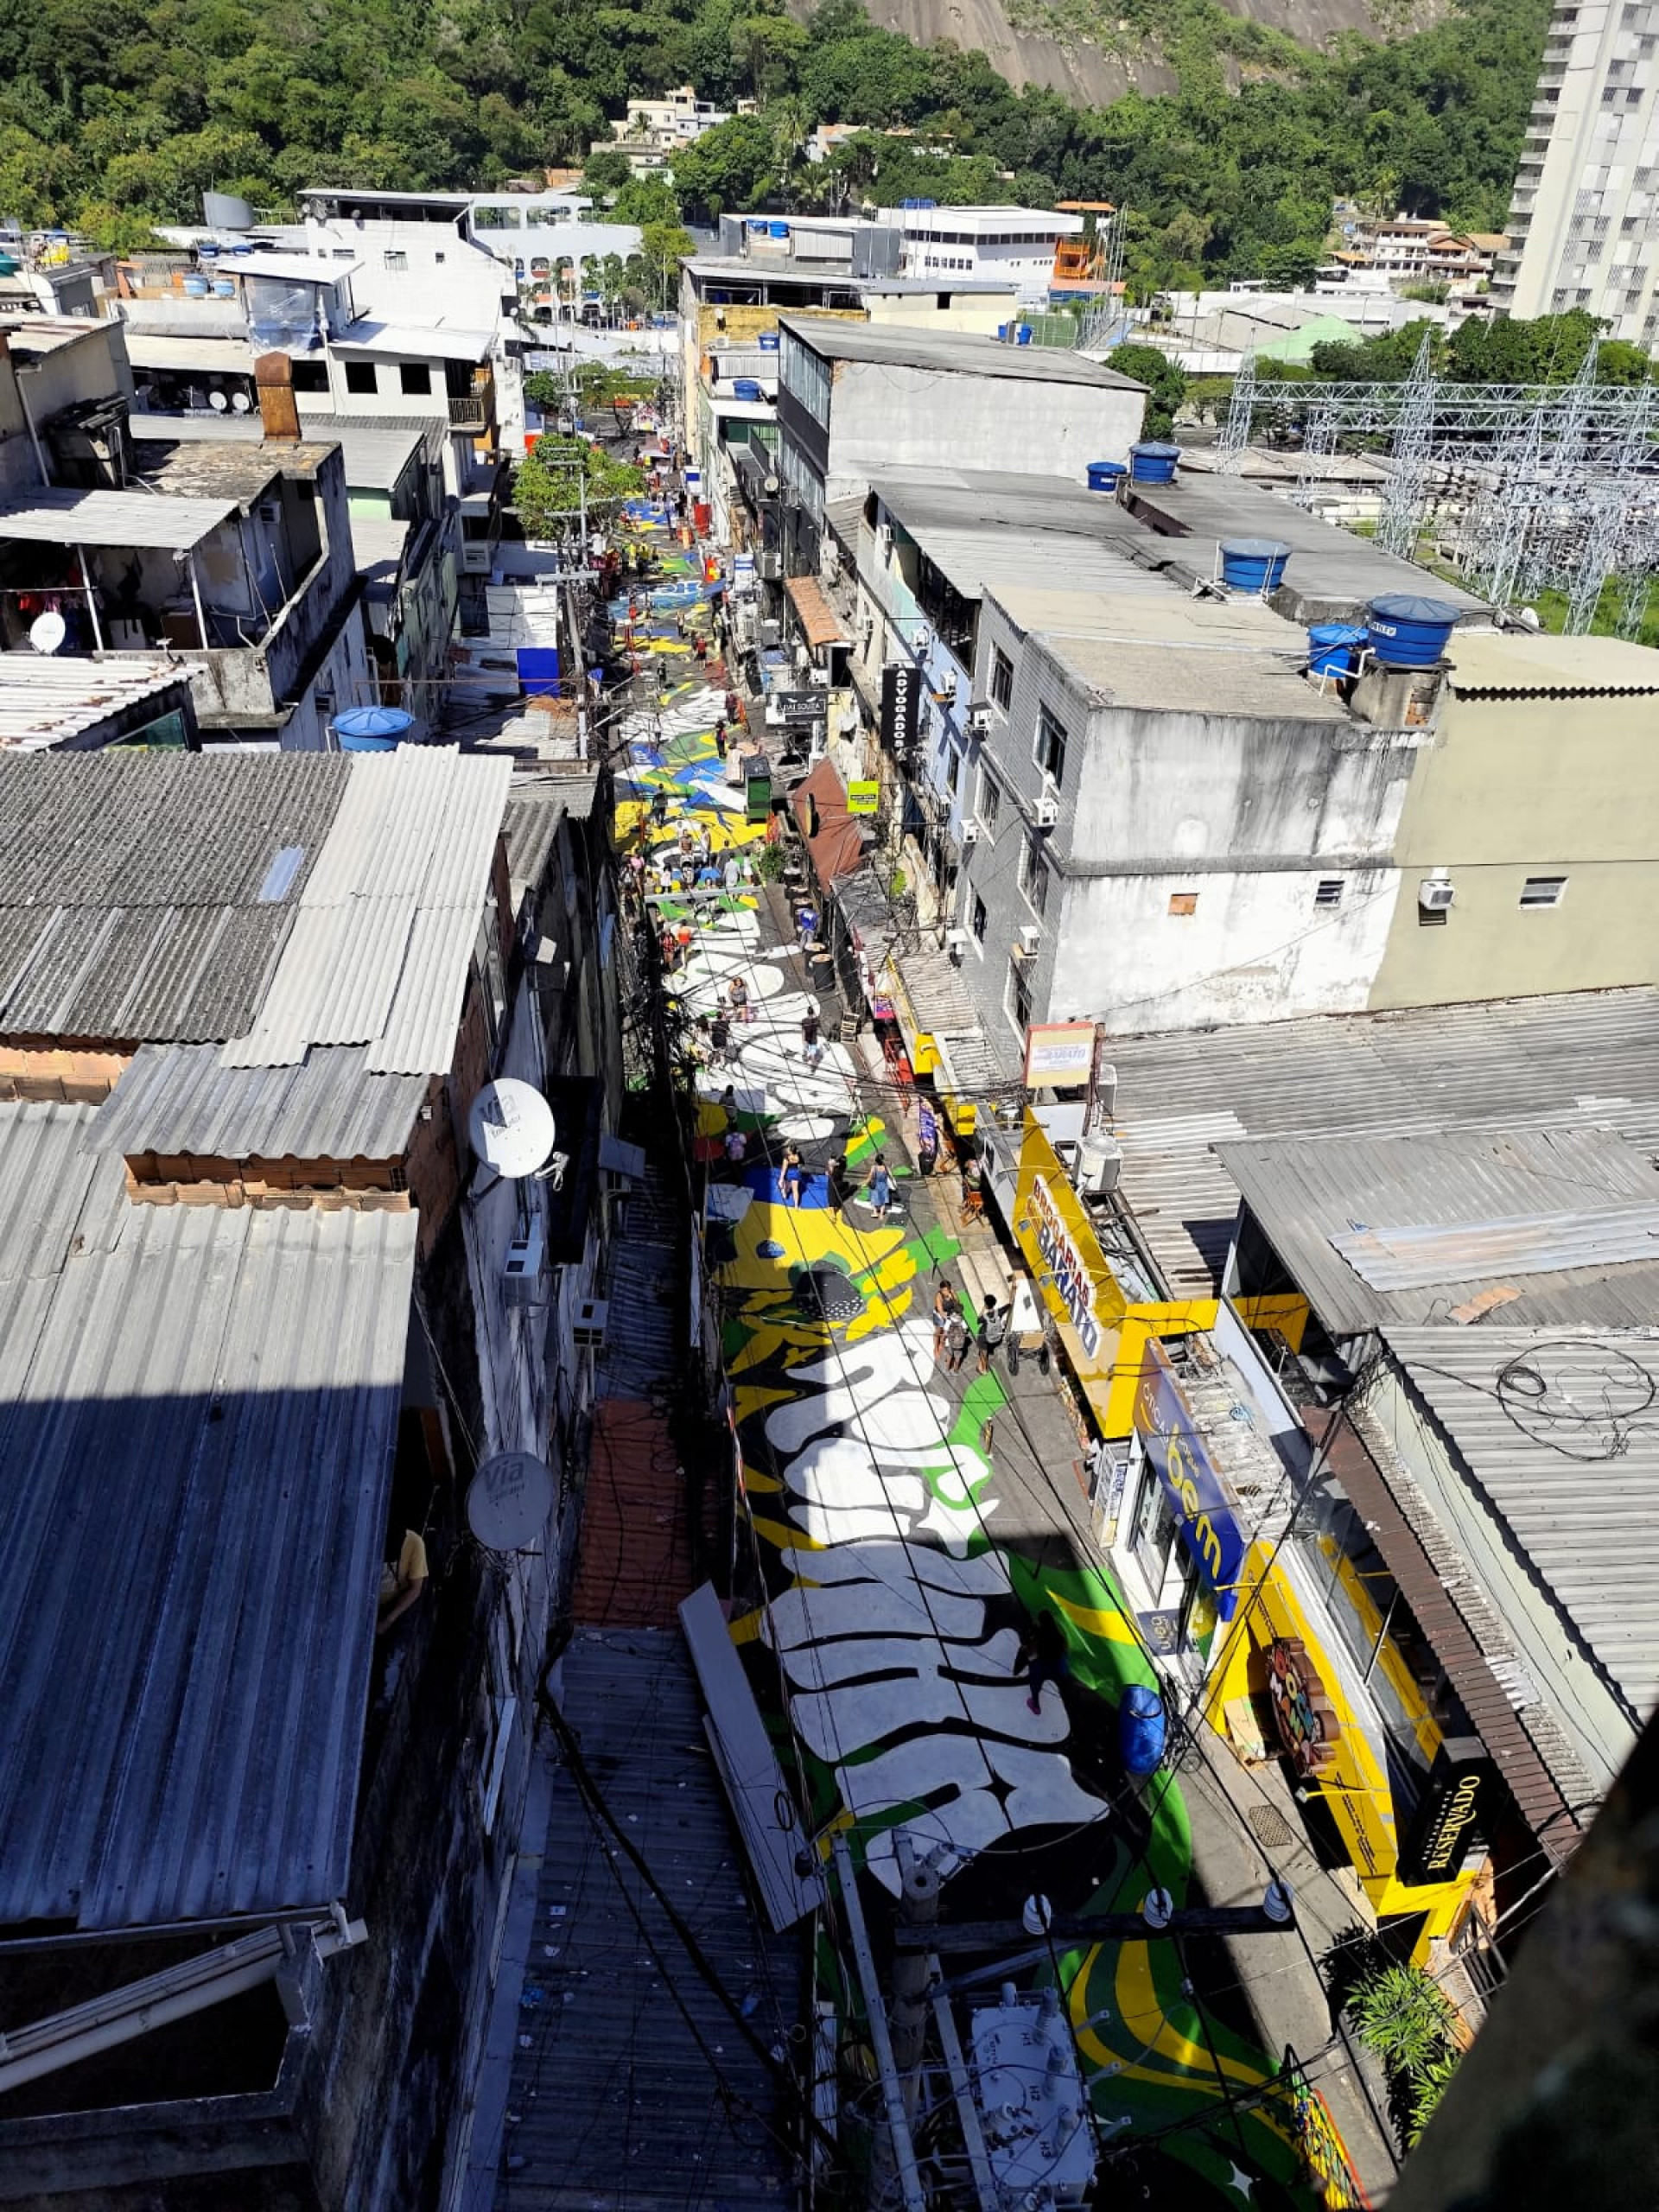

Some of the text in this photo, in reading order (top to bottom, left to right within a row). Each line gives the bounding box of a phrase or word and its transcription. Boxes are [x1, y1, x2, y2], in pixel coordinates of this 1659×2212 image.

[484, 1459, 524, 1493] Via
[1165, 1422, 1222, 1580] bem
[1427, 1775, 1481, 1871] RESERVADO
[1020, 2031, 1032, 2046] H1
[1029, 2085, 1041, 2102] H2
[1039, 2140, 1052, 2158] H3
